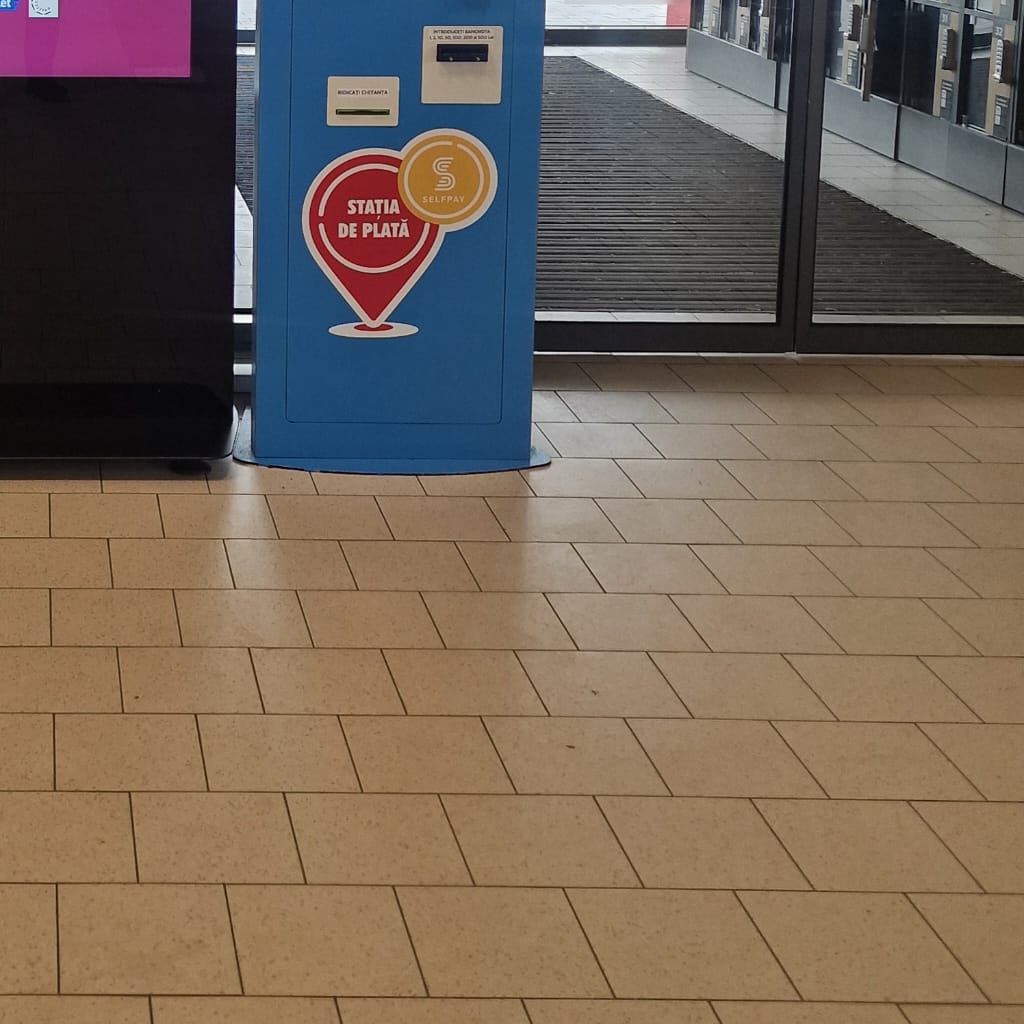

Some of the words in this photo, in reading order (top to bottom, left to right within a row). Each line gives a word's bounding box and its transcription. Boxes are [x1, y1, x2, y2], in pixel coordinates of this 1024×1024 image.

[423, 195, 465, 203] SELFPAY
[347, 199, 400, 220] STAȚIA
[338, 222, 357, 238] DE
[362, 218, 410, 238] PLATĂ
